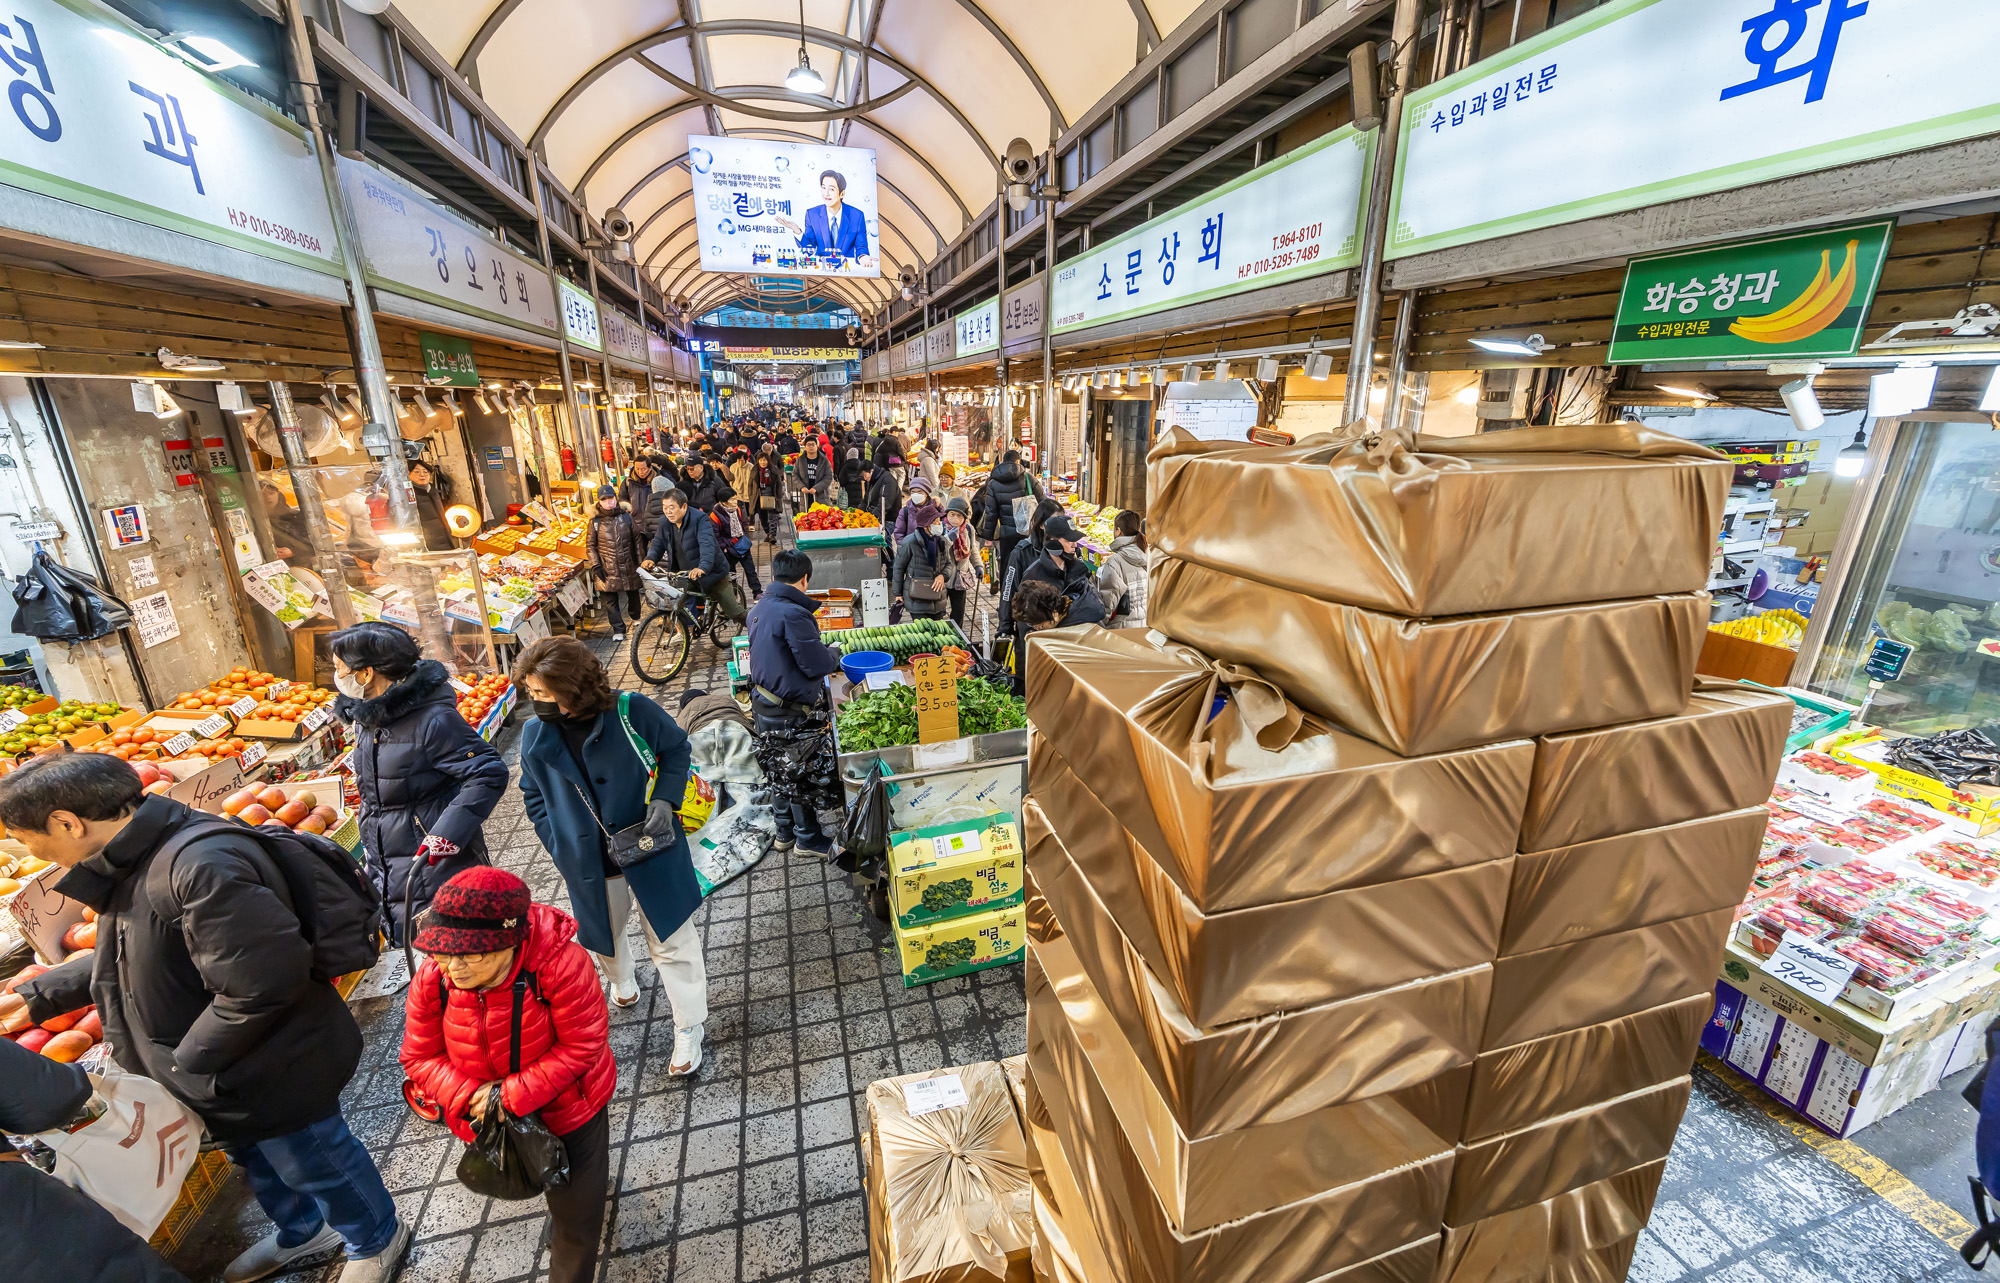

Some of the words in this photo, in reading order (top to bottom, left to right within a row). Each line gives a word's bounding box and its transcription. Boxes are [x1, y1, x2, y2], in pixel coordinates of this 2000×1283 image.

[1430, 63, 1560, 134] 수입과일전문
[707, 194, 732, 214] 당신
[733, 192, 764, 218] 곁에
[764, 198, 791, 216] 함께
[227, 207, 247, 228] H.P
[250, 215, 321, 253] 010-5389-0564
[737, 224, 751, 233] MG
[752, 225, 786, 234] 새마을금고
[1273, 222, 1322, 250] T.964-8101
[425, 226, 530, 312] 강오상회
[1097, 212, 1224, 301] 소문상회
[1238, 264, 1251, 278] H.P
[1254, 244, 1320, 274] 010-5295-7489
[1643, 268, 1779, 313] 화승청과
[1637, 320, 1710, 340] 수입과일전문
[172, 454, 193, 471] CCT
[976, 867, 996, 881] 비금
[989, 879, 1008, 895] 섬초
[979, 926, 999, 941] 비금
[992, 938, 1011, 954] 섬초
